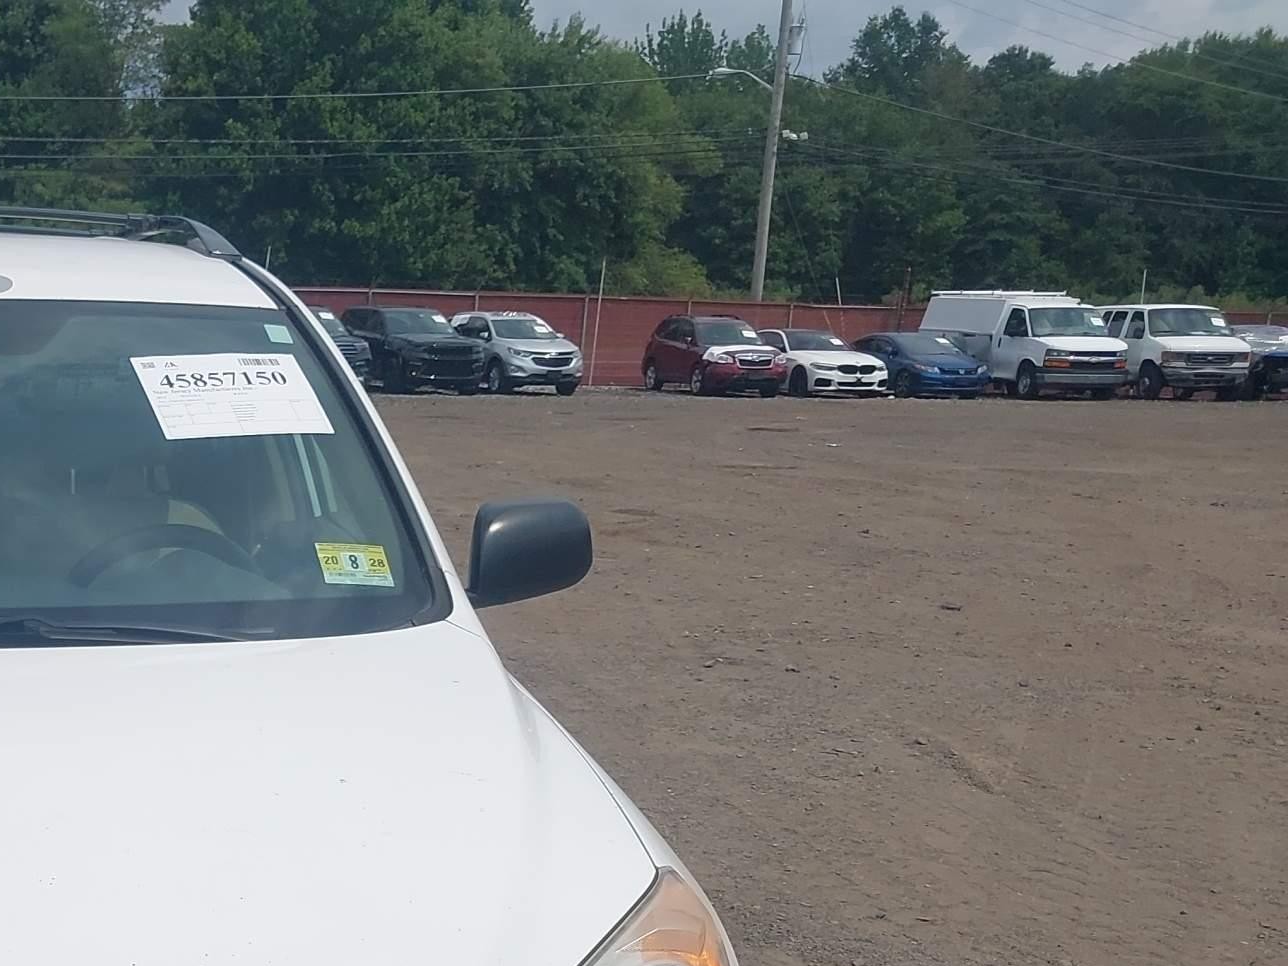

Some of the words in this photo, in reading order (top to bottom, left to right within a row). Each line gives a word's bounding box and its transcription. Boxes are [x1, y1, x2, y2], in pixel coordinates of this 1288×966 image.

[159, 371, 287, 388] 45857150
[322, 555, 339, 565] 20
[348, 554, 360, 570] 8
[368, 558, 386, 568] 28
